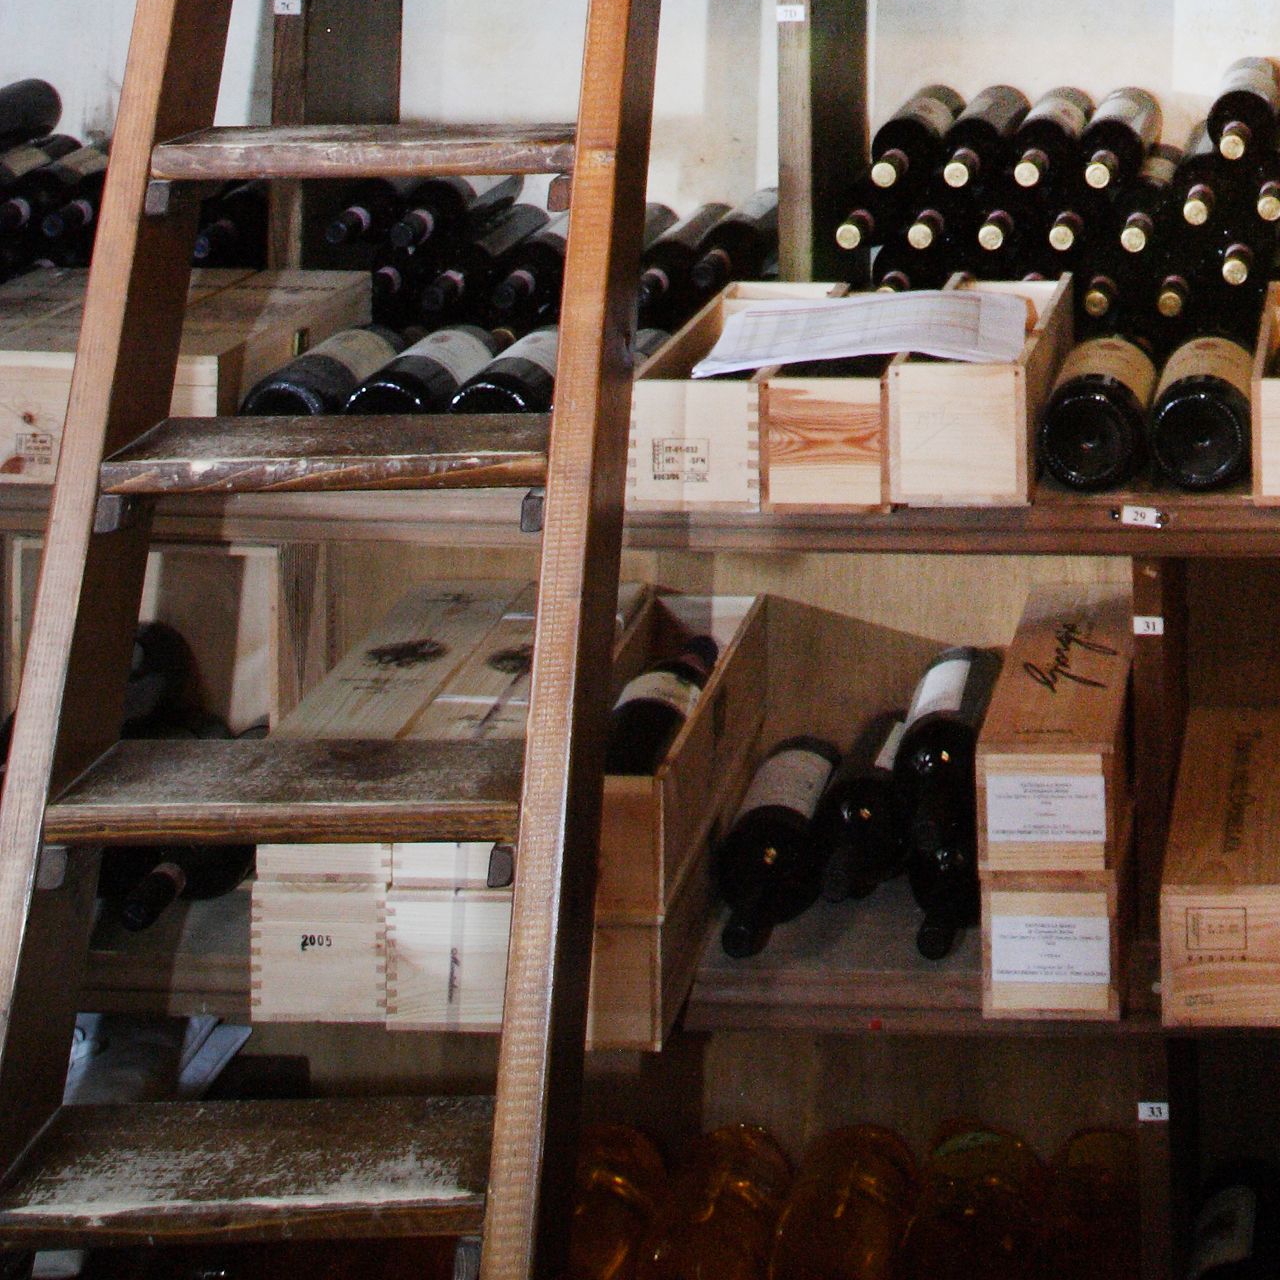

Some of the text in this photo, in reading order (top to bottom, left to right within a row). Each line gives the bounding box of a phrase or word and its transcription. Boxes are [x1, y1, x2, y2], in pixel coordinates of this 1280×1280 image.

[1132, 510, 1146, 522] 29
[1143, 620, 1156, 632] 31
[301, 934, 333, 951] 2005
[1147, 1106, 1162, 1118] 33
